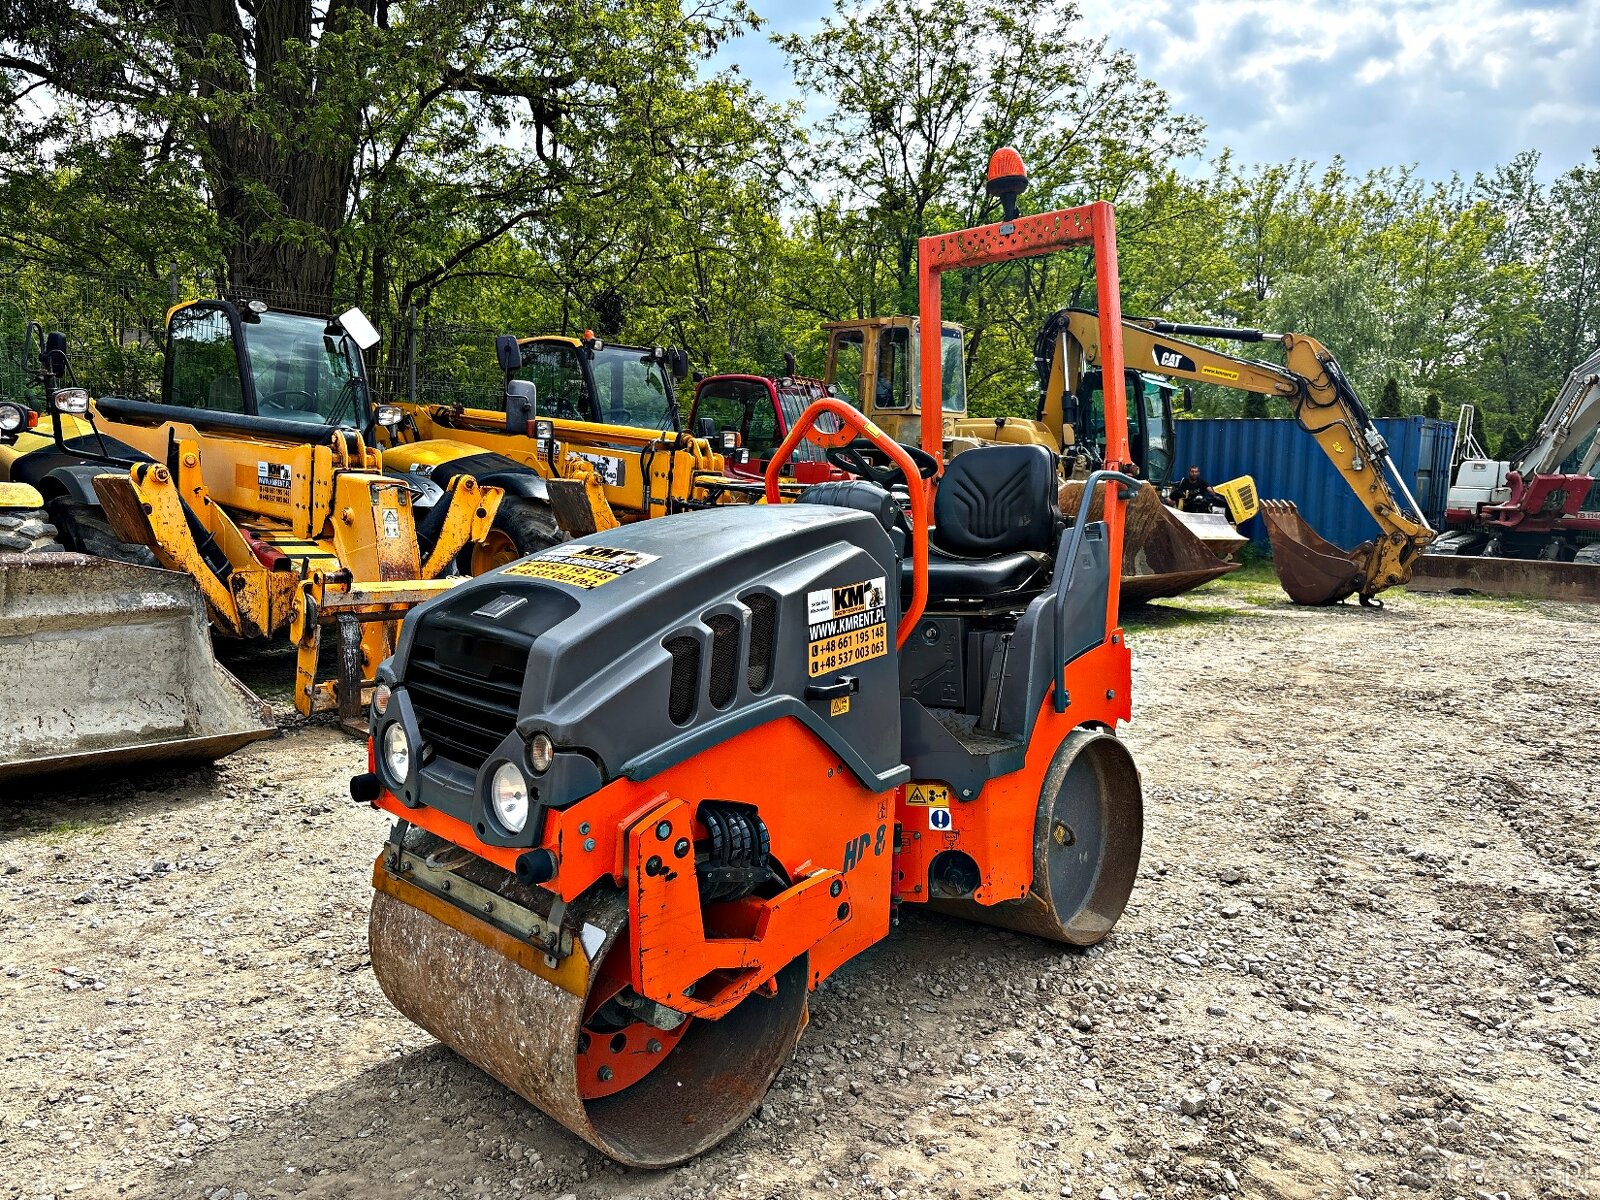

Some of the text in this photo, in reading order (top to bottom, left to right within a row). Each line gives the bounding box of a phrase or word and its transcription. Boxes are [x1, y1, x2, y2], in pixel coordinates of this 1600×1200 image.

[1160, 352, 1182, 367] CAT
[577, 546, 626, 559] KM
[834, 584, 864, 611] KM
[809, 607, 886, 641] WWW.KMRENT.PL
[820, 626, 884, 655] +48 661 195 148
[820, 641, 884, 670] +48 537 003 063
[874, 824, 886, 856] 8
